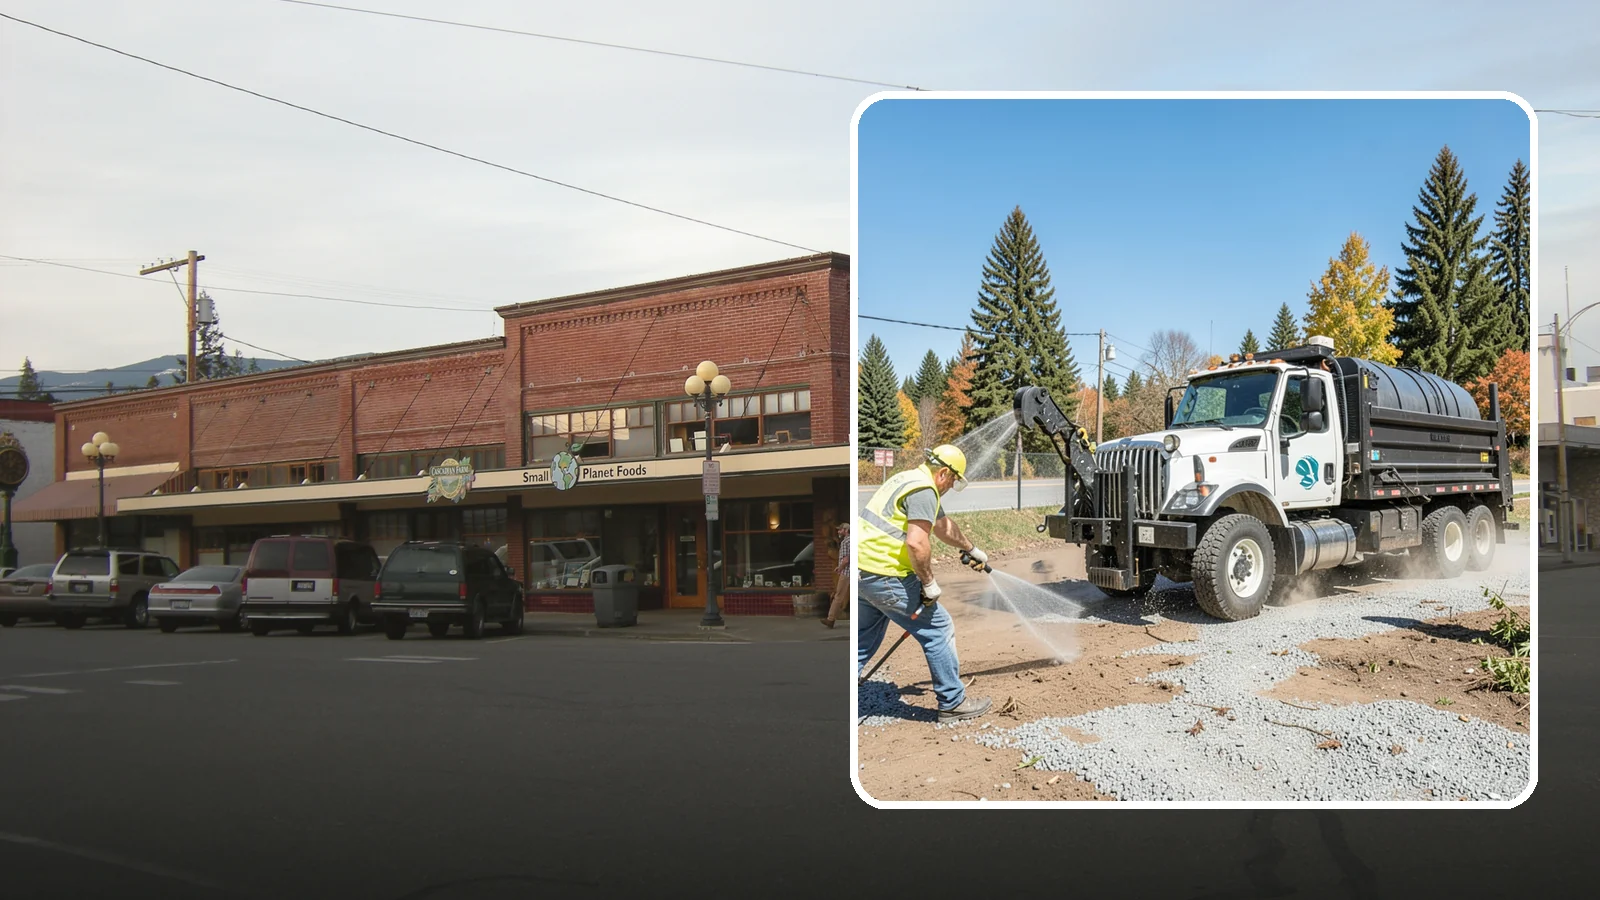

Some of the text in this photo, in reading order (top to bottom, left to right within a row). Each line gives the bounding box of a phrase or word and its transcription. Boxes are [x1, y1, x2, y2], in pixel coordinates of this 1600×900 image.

[523, 464, 647, 483] Small Planet Foods
